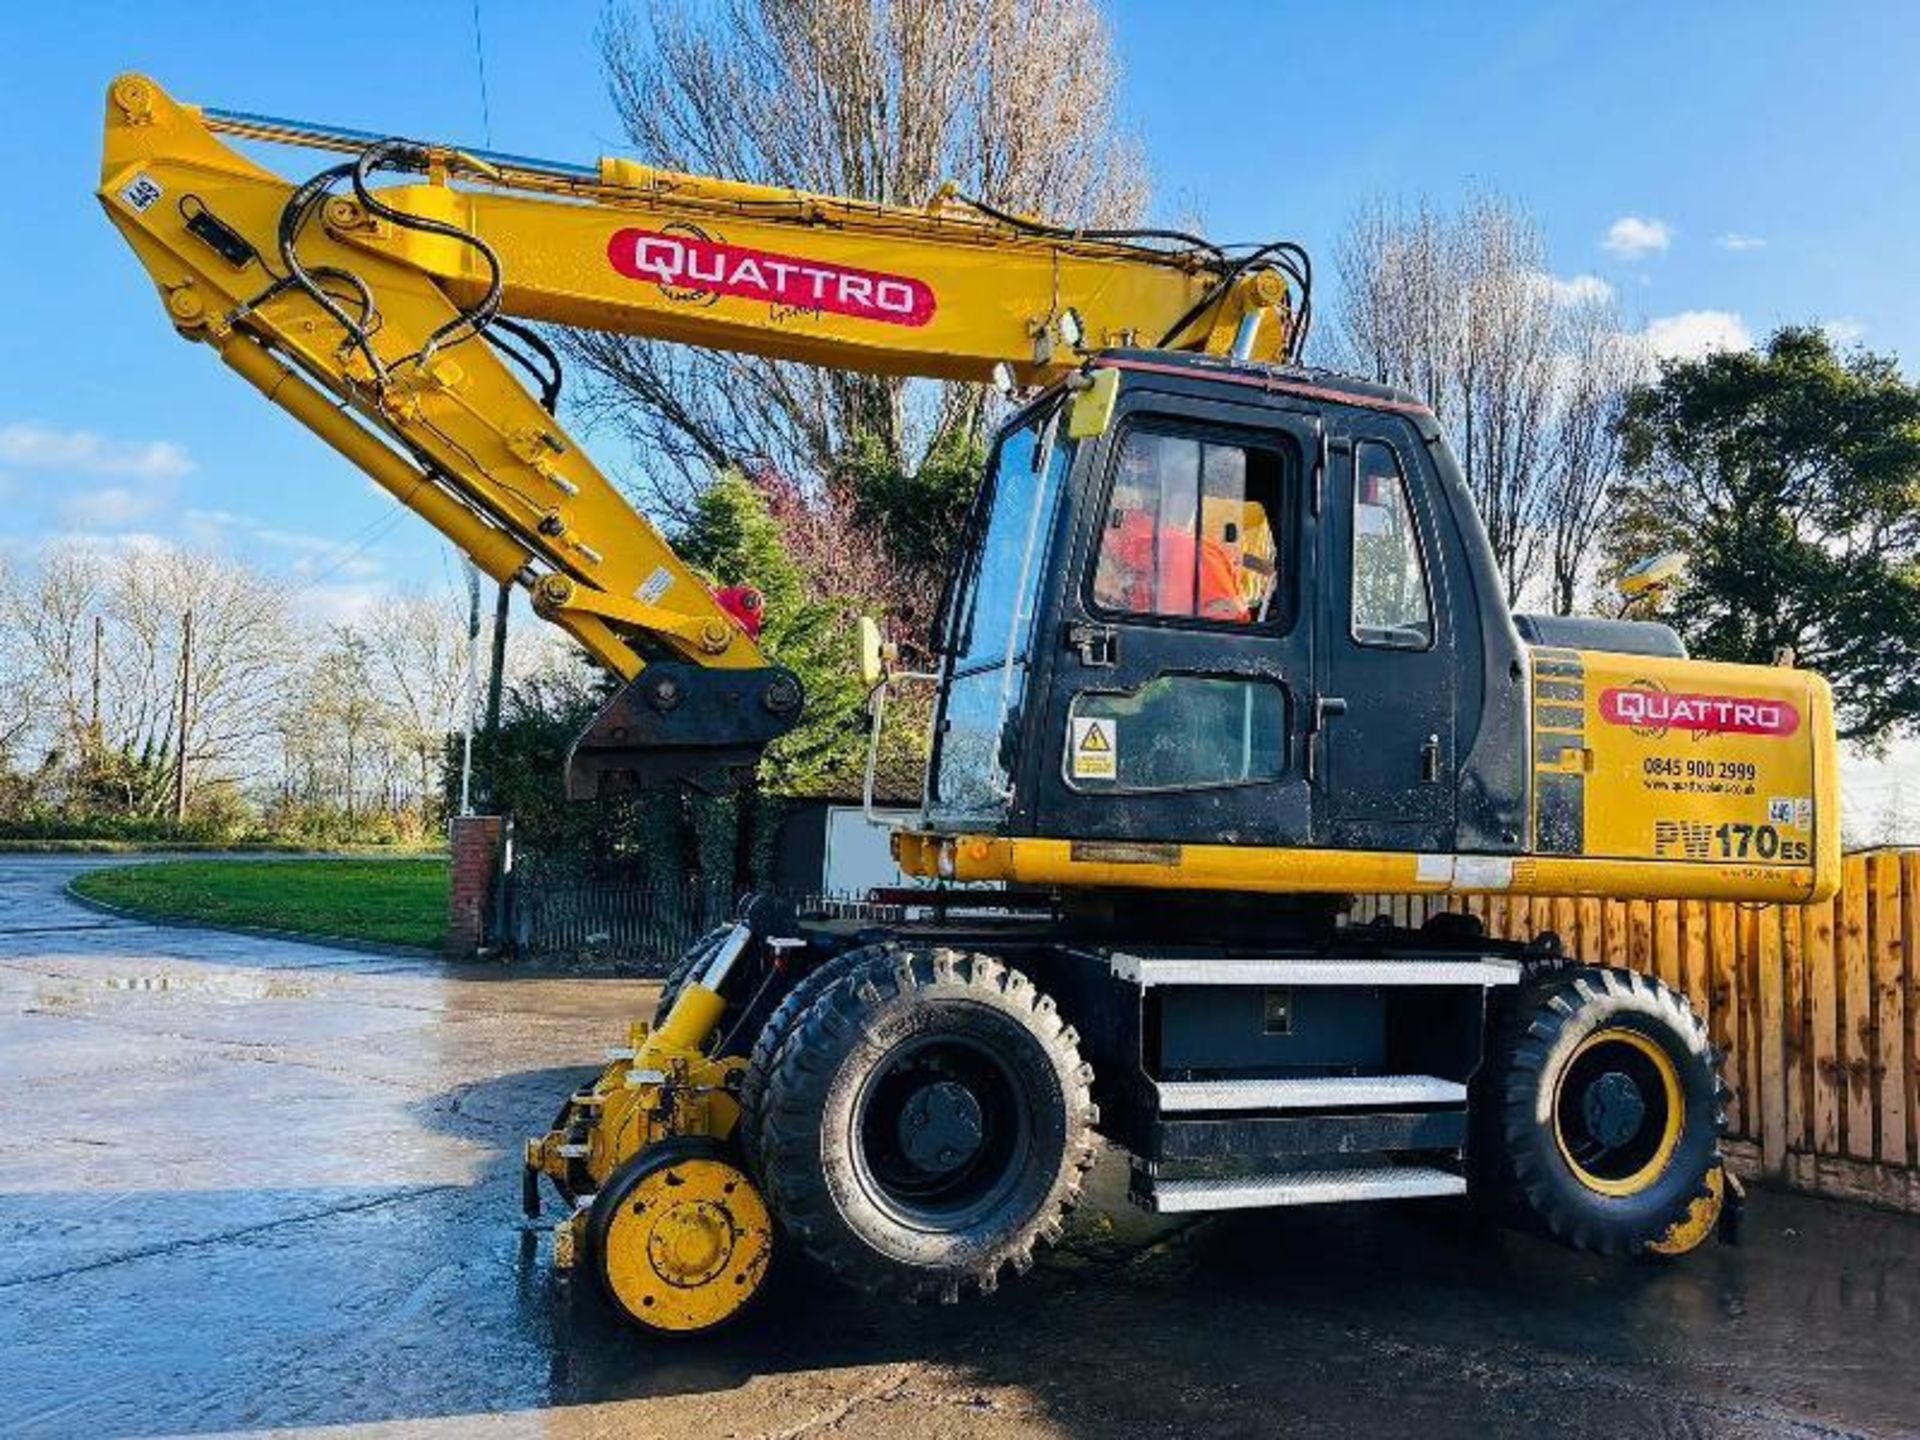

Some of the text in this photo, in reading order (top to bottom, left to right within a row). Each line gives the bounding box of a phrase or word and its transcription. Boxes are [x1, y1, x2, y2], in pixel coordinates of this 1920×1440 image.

[634, 236, 914, 314] QUATTRO
[1616, 692, 1780, 728] QUATTRO
[1643, 757, 1756, 781] 0845 900 2999
